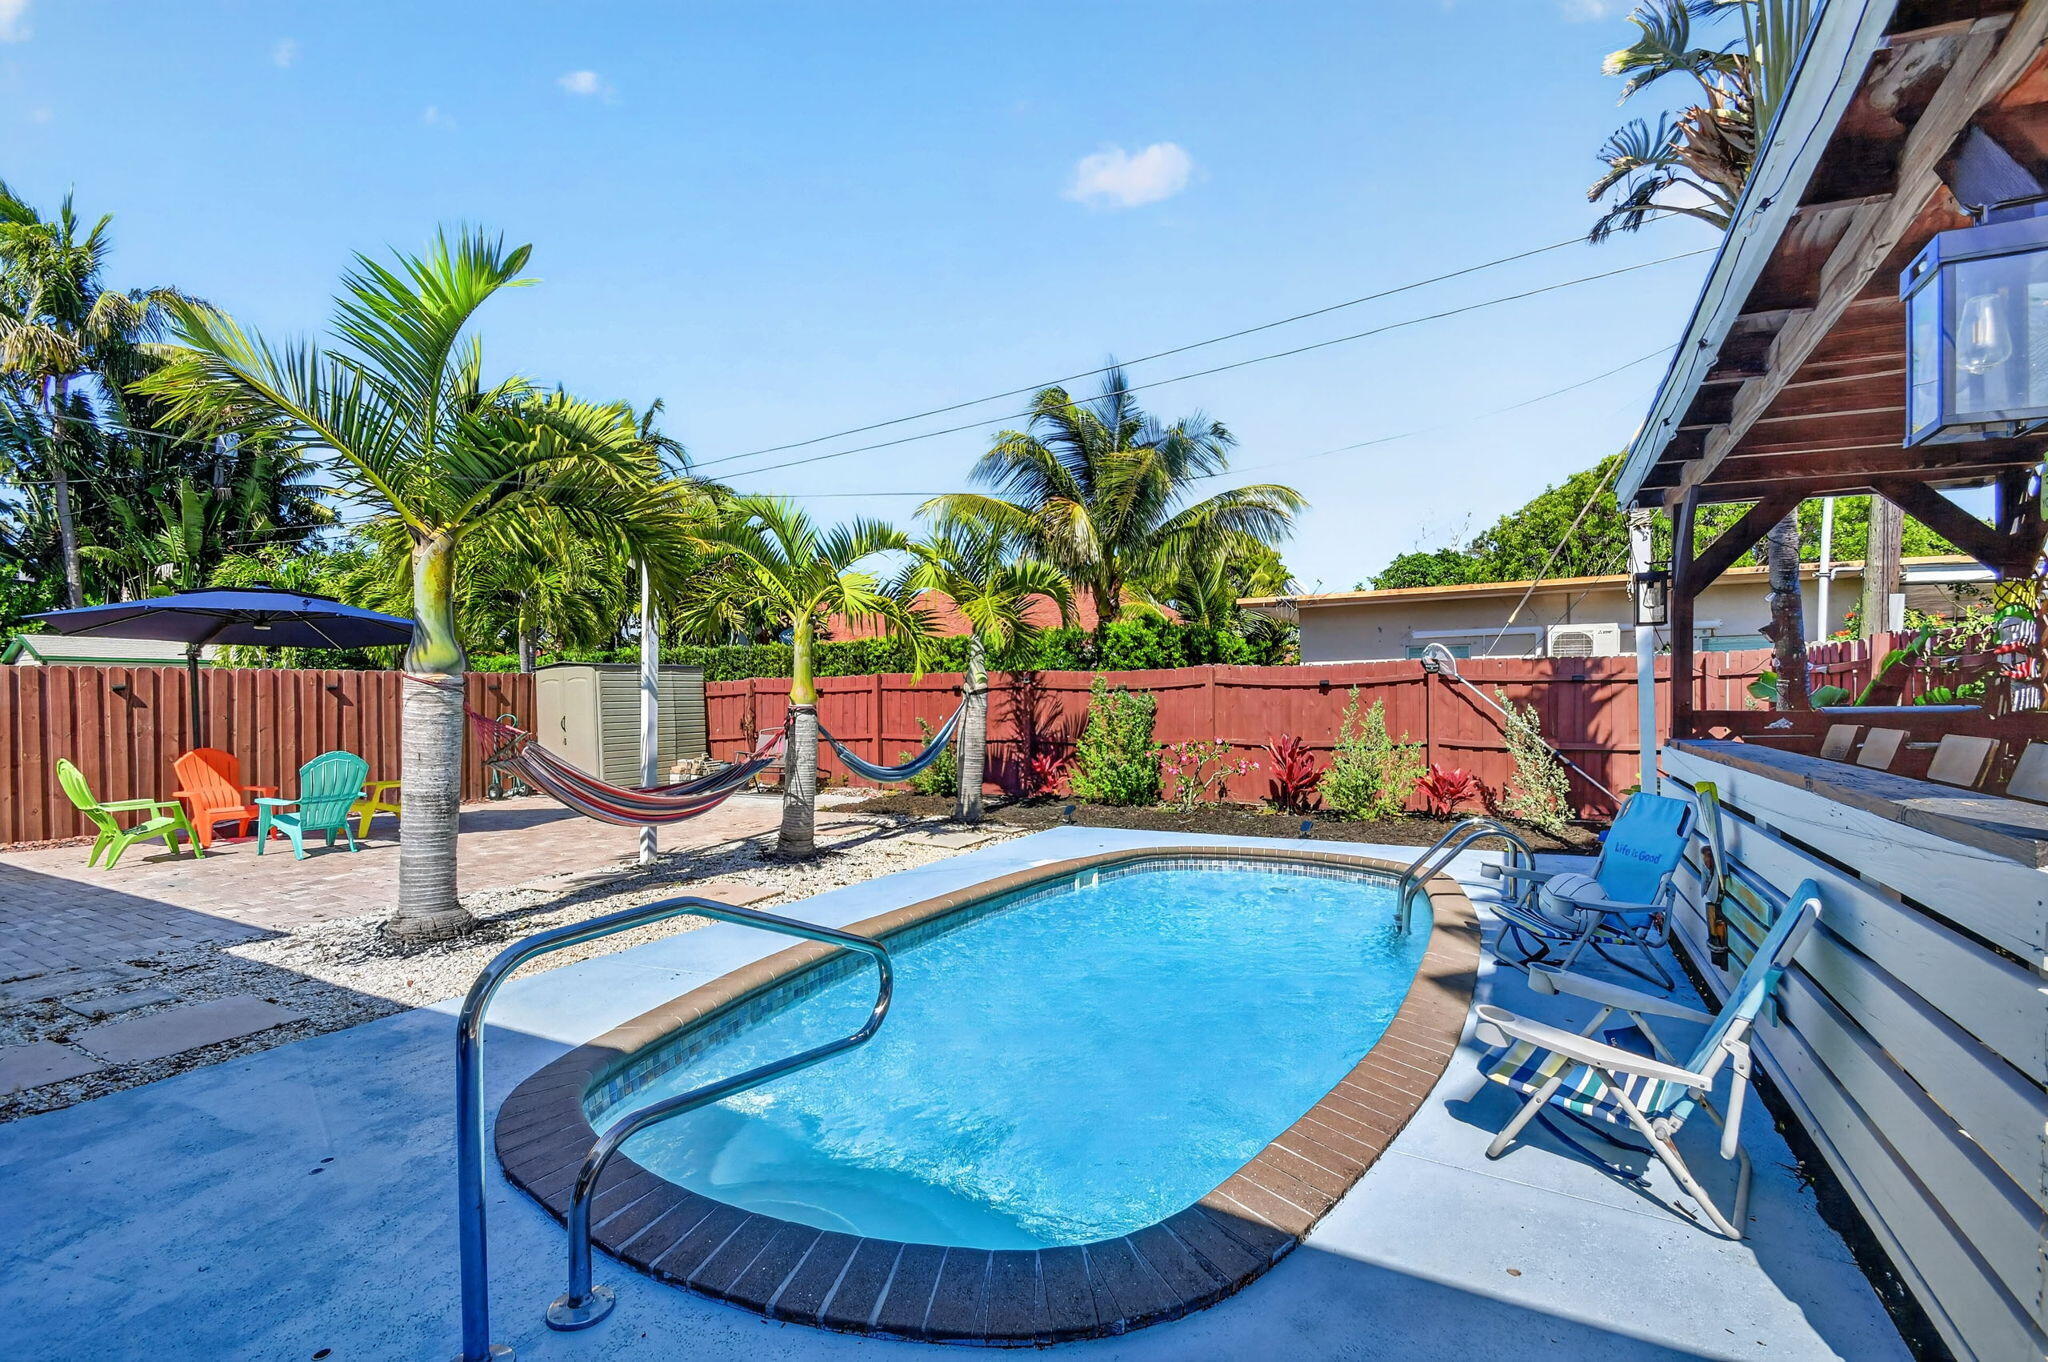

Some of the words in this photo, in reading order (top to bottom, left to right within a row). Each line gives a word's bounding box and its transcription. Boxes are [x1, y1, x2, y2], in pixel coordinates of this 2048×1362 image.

[1615, 842, 1631, 856] Life
[1631, 848, 1638, 857] is
[1638, 850, 1662, 864] Good
